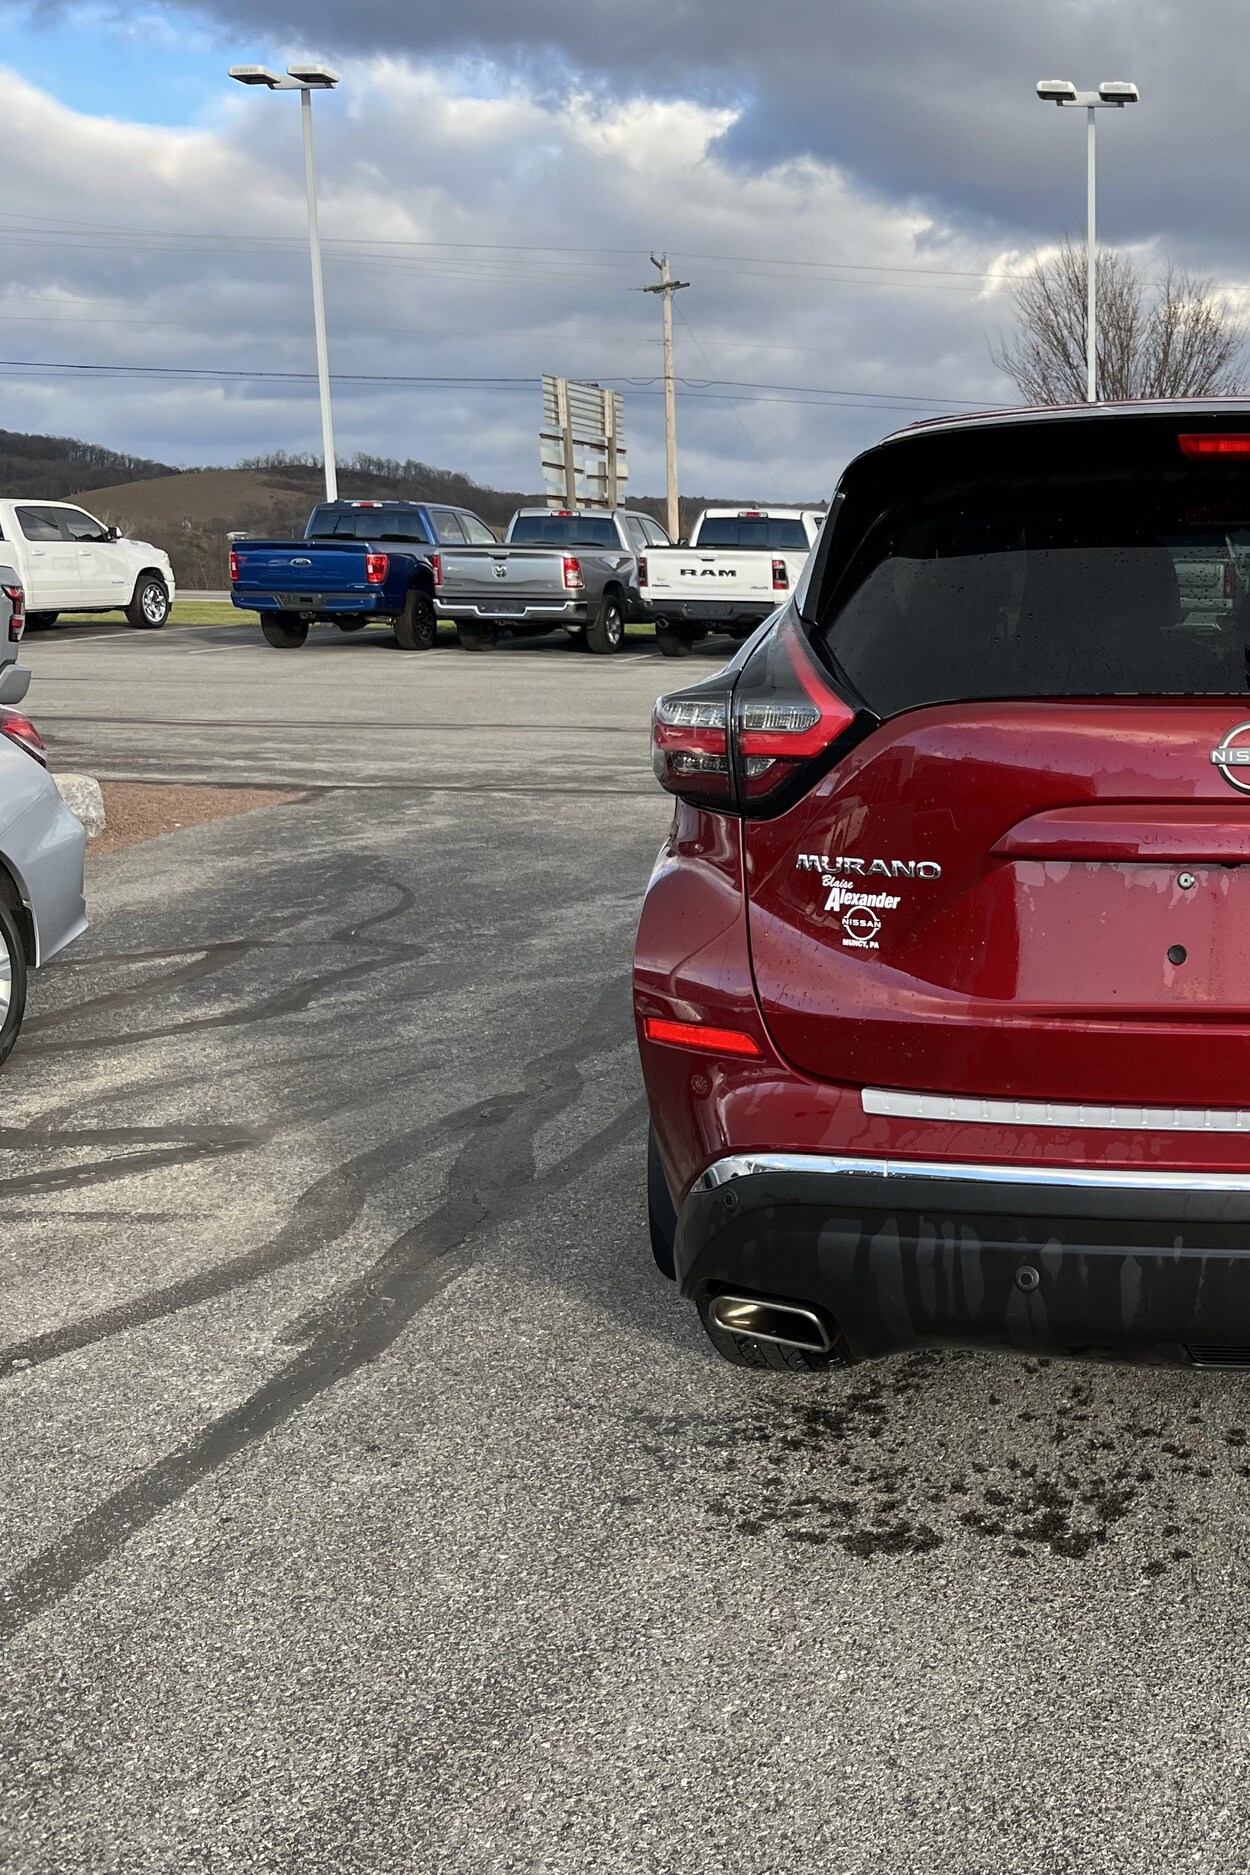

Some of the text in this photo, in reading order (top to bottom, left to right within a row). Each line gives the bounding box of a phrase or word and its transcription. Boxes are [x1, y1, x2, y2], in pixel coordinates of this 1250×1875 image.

[680, 568, 737, 577] RAM
[796, 854, 942, 880] MURANO
[821, 874, 854, 888] Blaise
[824, 887, 901, 912] Alexander
[841, 917, 882, 929] NISSAN
[842, 938, 880, 949] MUNCY, PA
